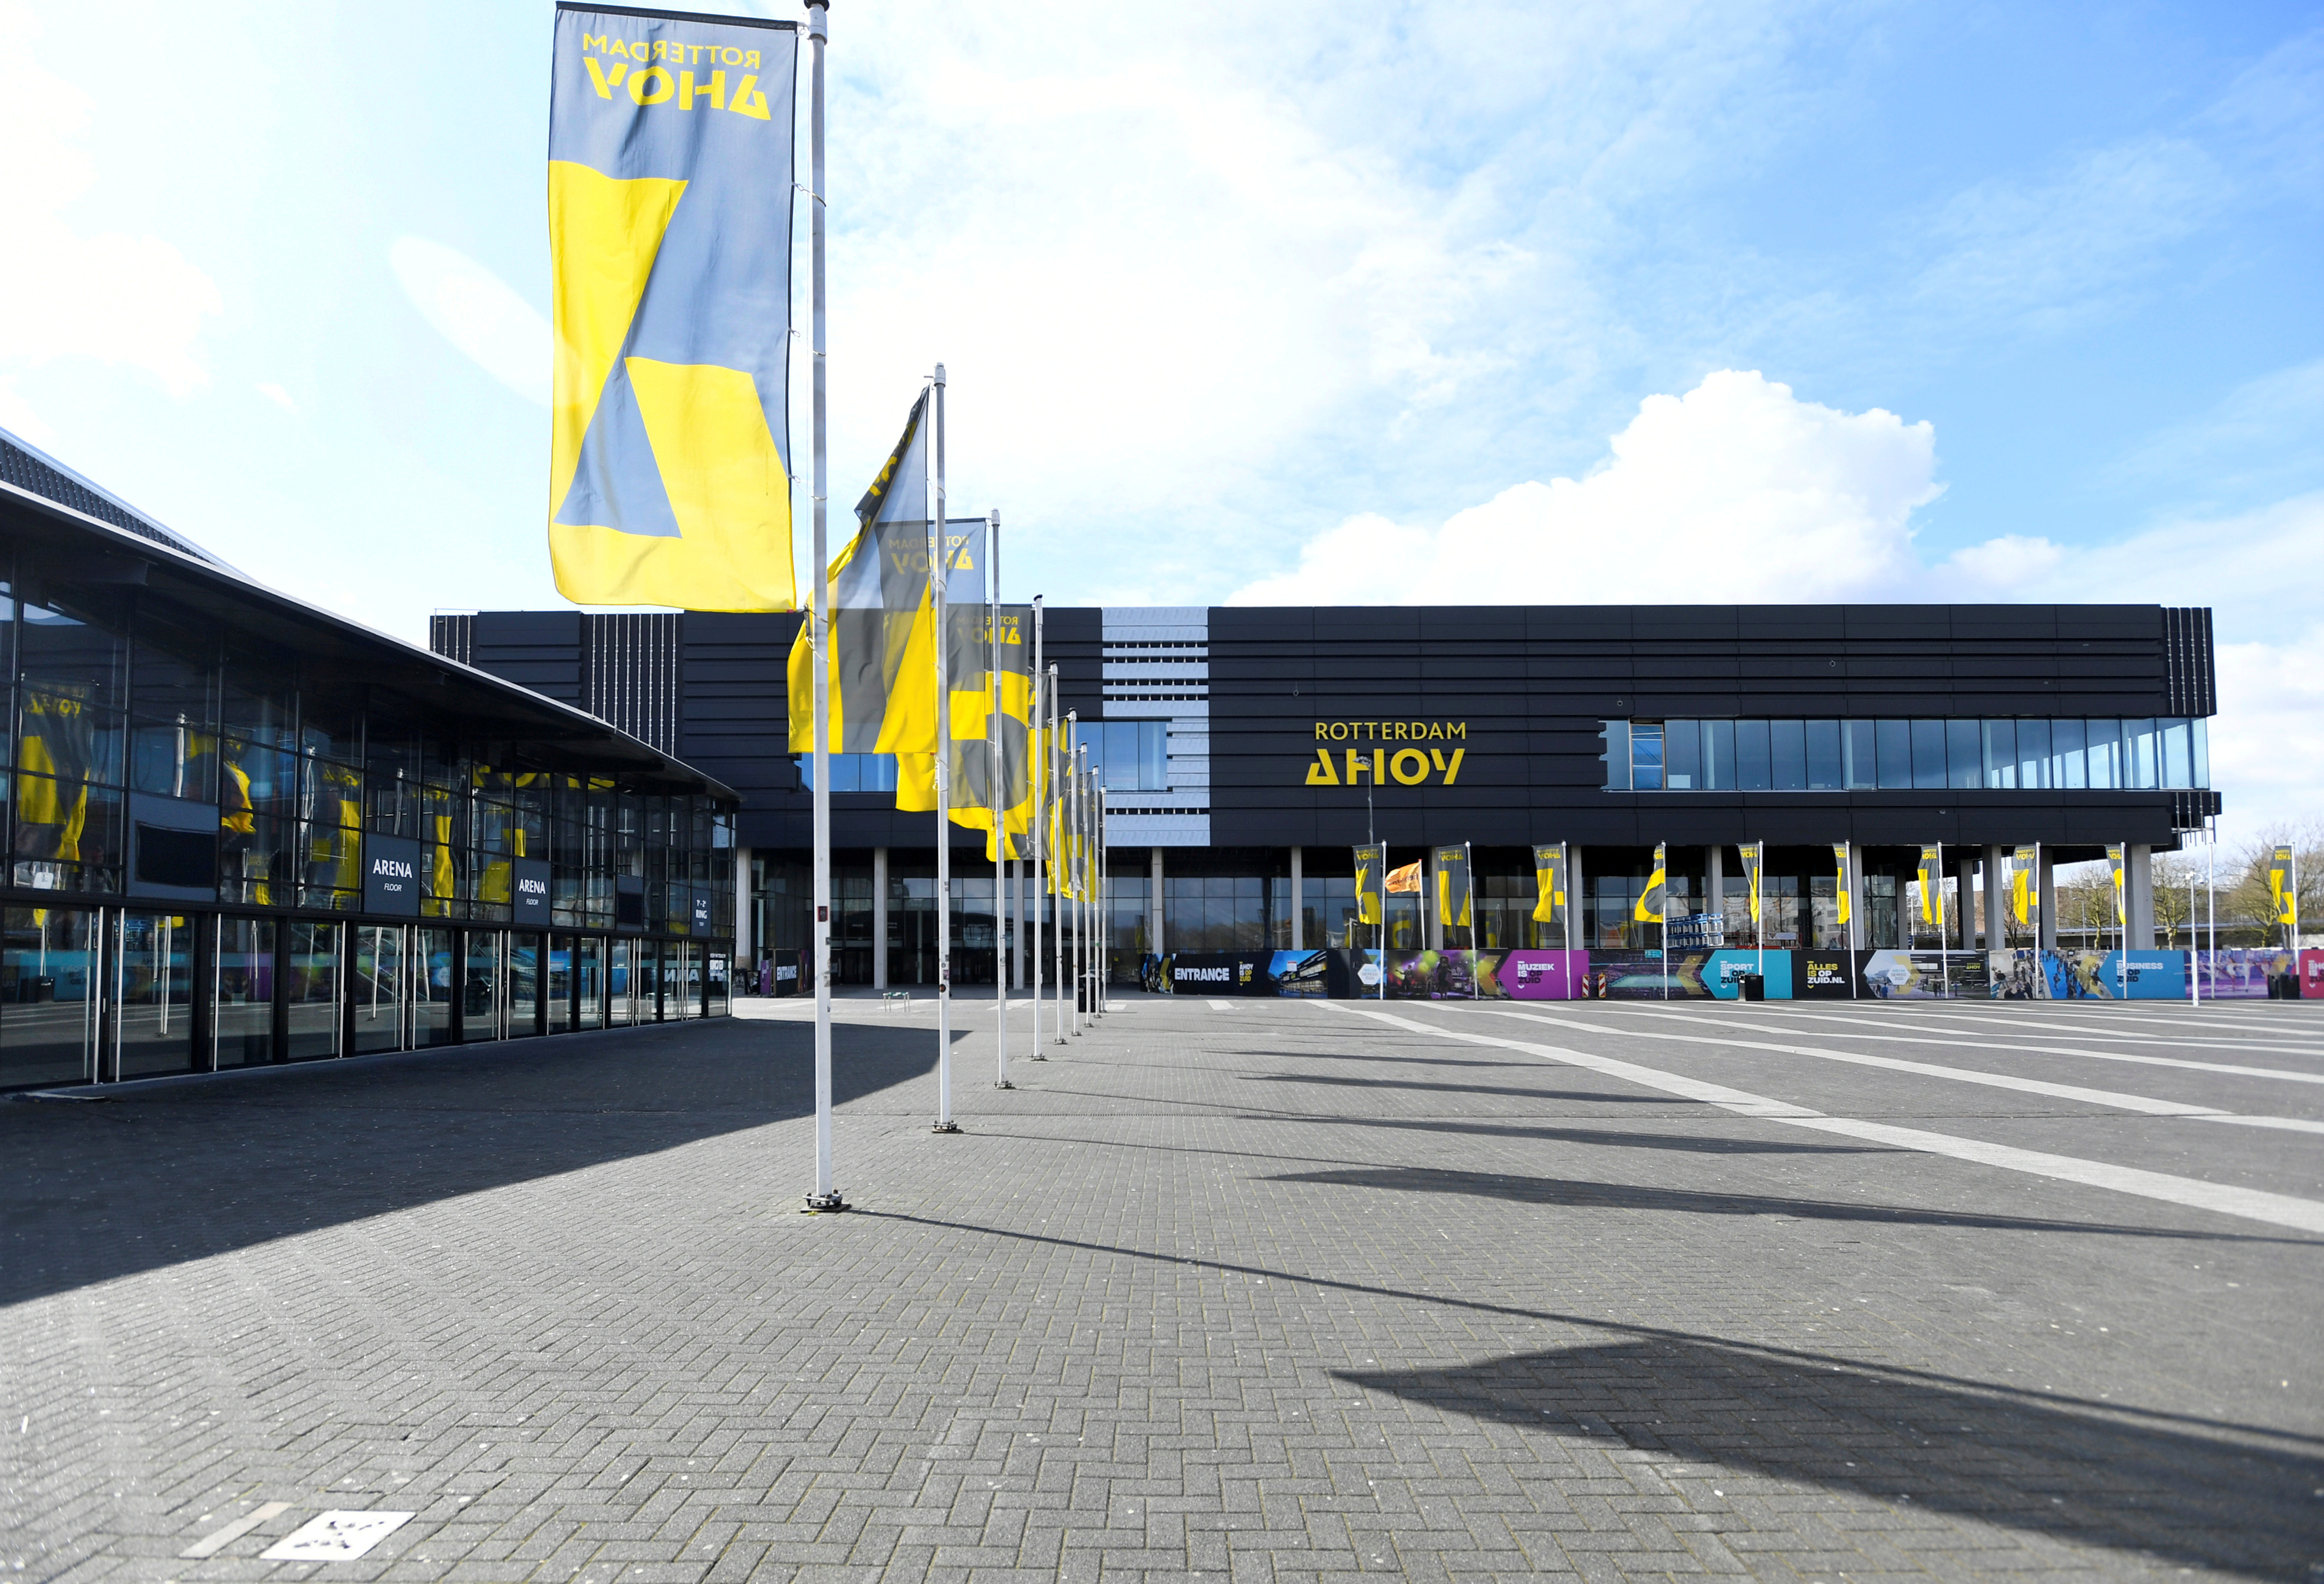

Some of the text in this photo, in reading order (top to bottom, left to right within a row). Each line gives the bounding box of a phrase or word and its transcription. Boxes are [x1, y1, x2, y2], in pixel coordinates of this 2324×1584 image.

[1315, 722, 1466, 740] ROTTERDAM
[1305, 748, 1466, 785] AHOY
[373, 858, 413, 878] ARENA
[384, 883, 402, 891] FLOOR
[519, 878, 546, 894] ARENA
[776, 965, 797, 981] ENTRANCE
[1174, 967, 1230, 982] ENTRANCE
